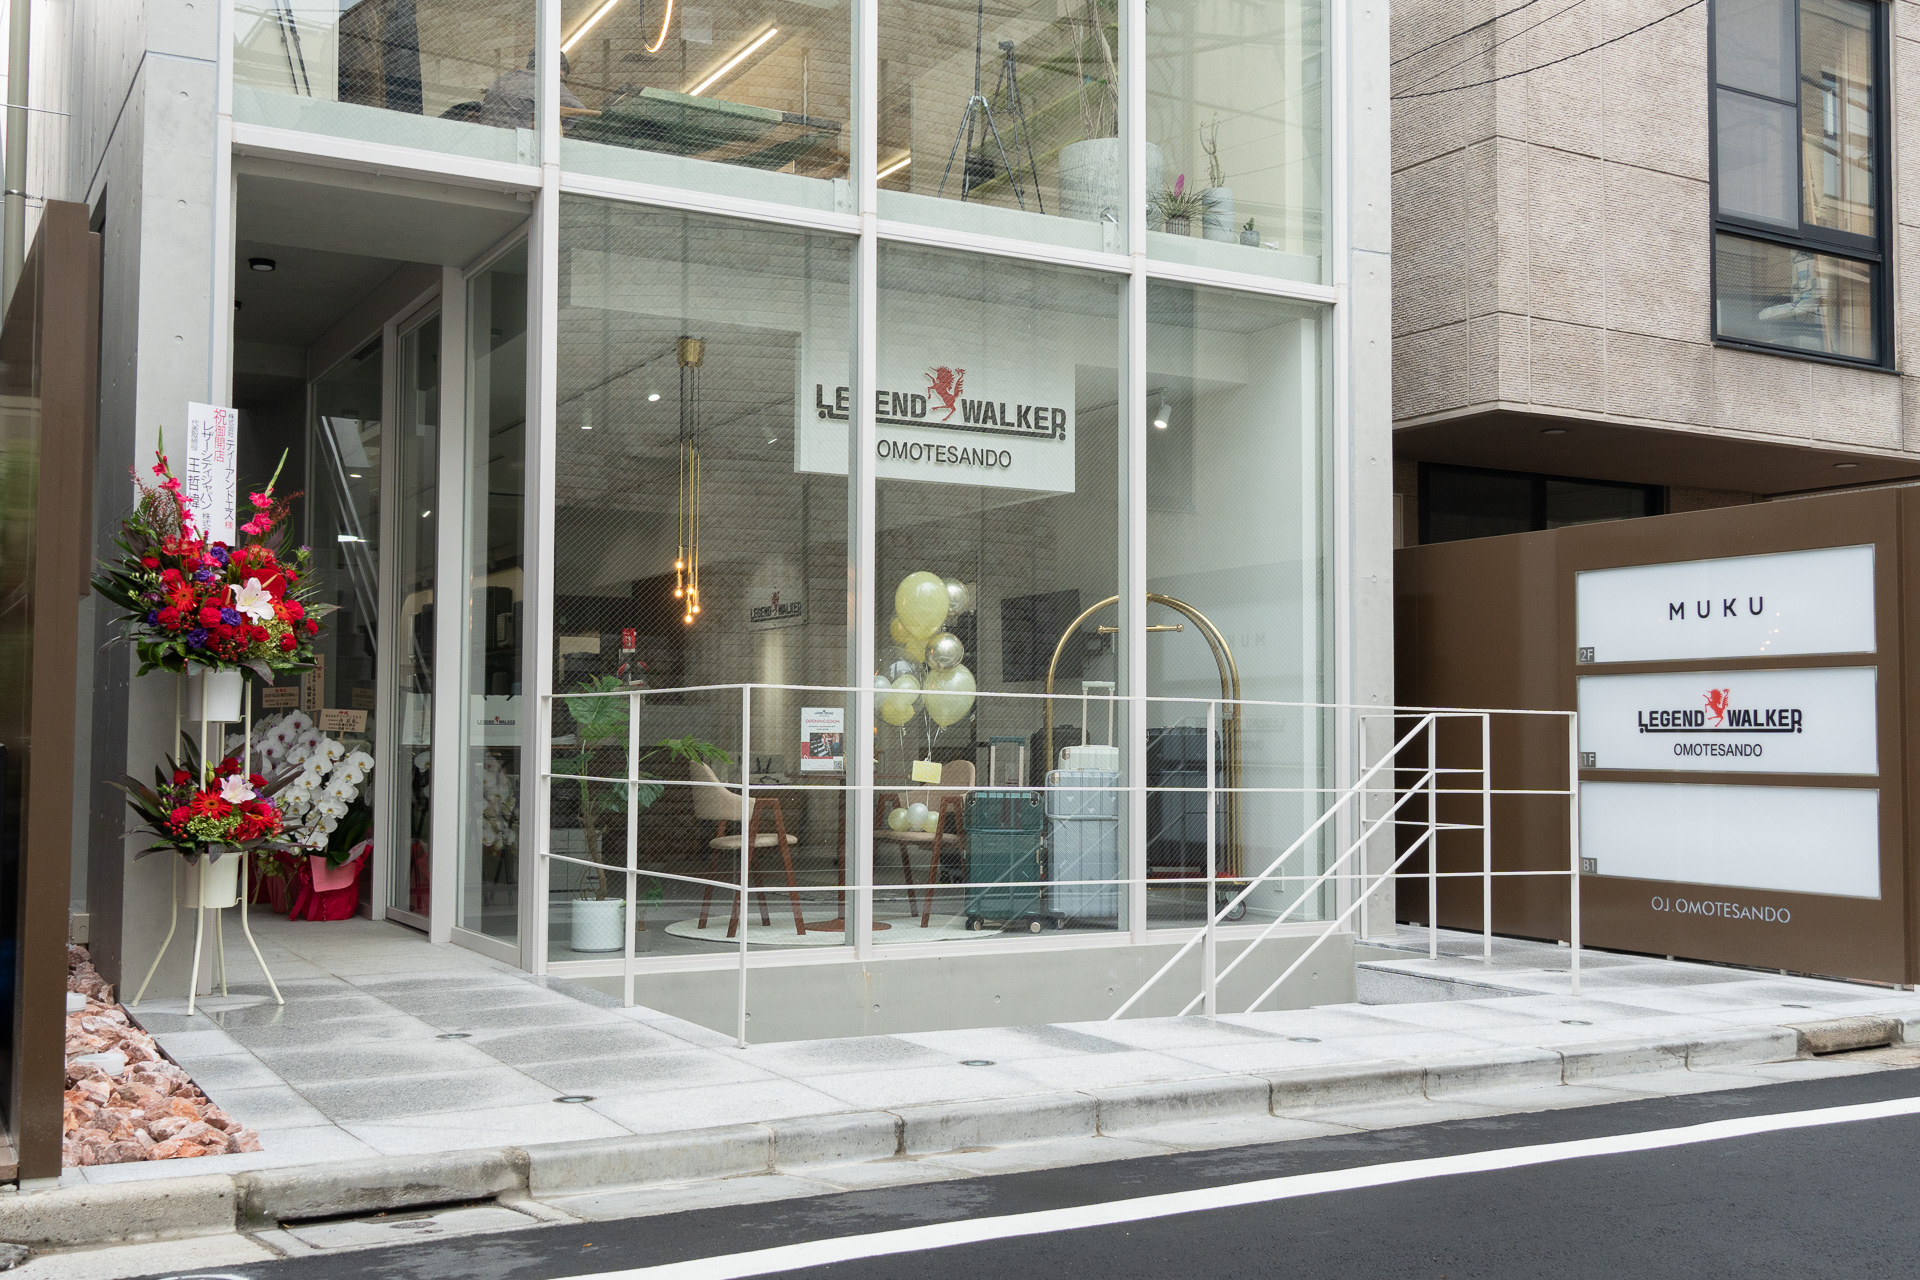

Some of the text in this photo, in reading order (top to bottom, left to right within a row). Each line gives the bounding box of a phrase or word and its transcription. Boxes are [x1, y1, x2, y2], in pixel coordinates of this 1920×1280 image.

[816, 384, 1067, 438] LEEND WALKER
[213, 407, 227, 463] 祝御開店
[877, 439, 1012, 468] OMOTESANDO
[1669, 596, 1764, 620] MUKU
[1580, 649, 1594, 661] 2F
[1638, 709, 1803, 731] LEGEND WALKER
[1583, 753, 1595, 766] 1F
[1673, 743, 1763, 757] OMOTESANDO
[1583, 859, 1595, 872] B1
